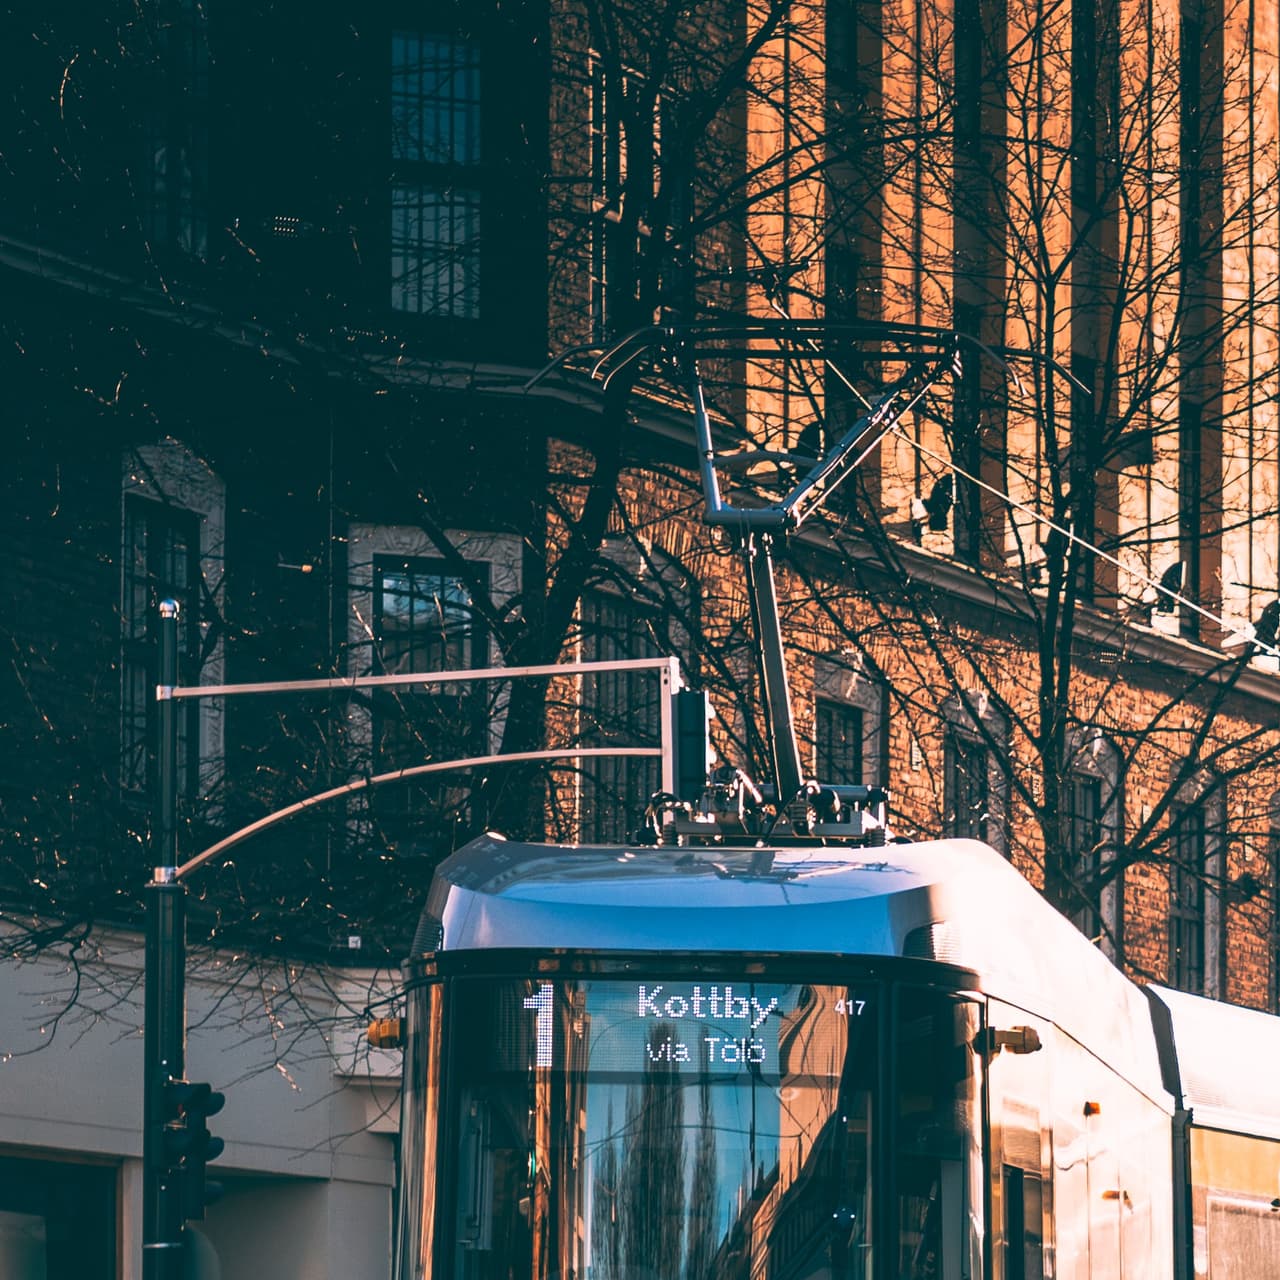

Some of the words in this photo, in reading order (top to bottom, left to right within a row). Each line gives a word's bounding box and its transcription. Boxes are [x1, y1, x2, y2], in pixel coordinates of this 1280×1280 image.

[833, 998, 866, 1017] 417
[523, 983, 554, 1068] 1
[638, 984, 779, 1030] Kottby
[645, 1036, 691, 1064] via
[704, 1036, 768, 1064] Tölö
